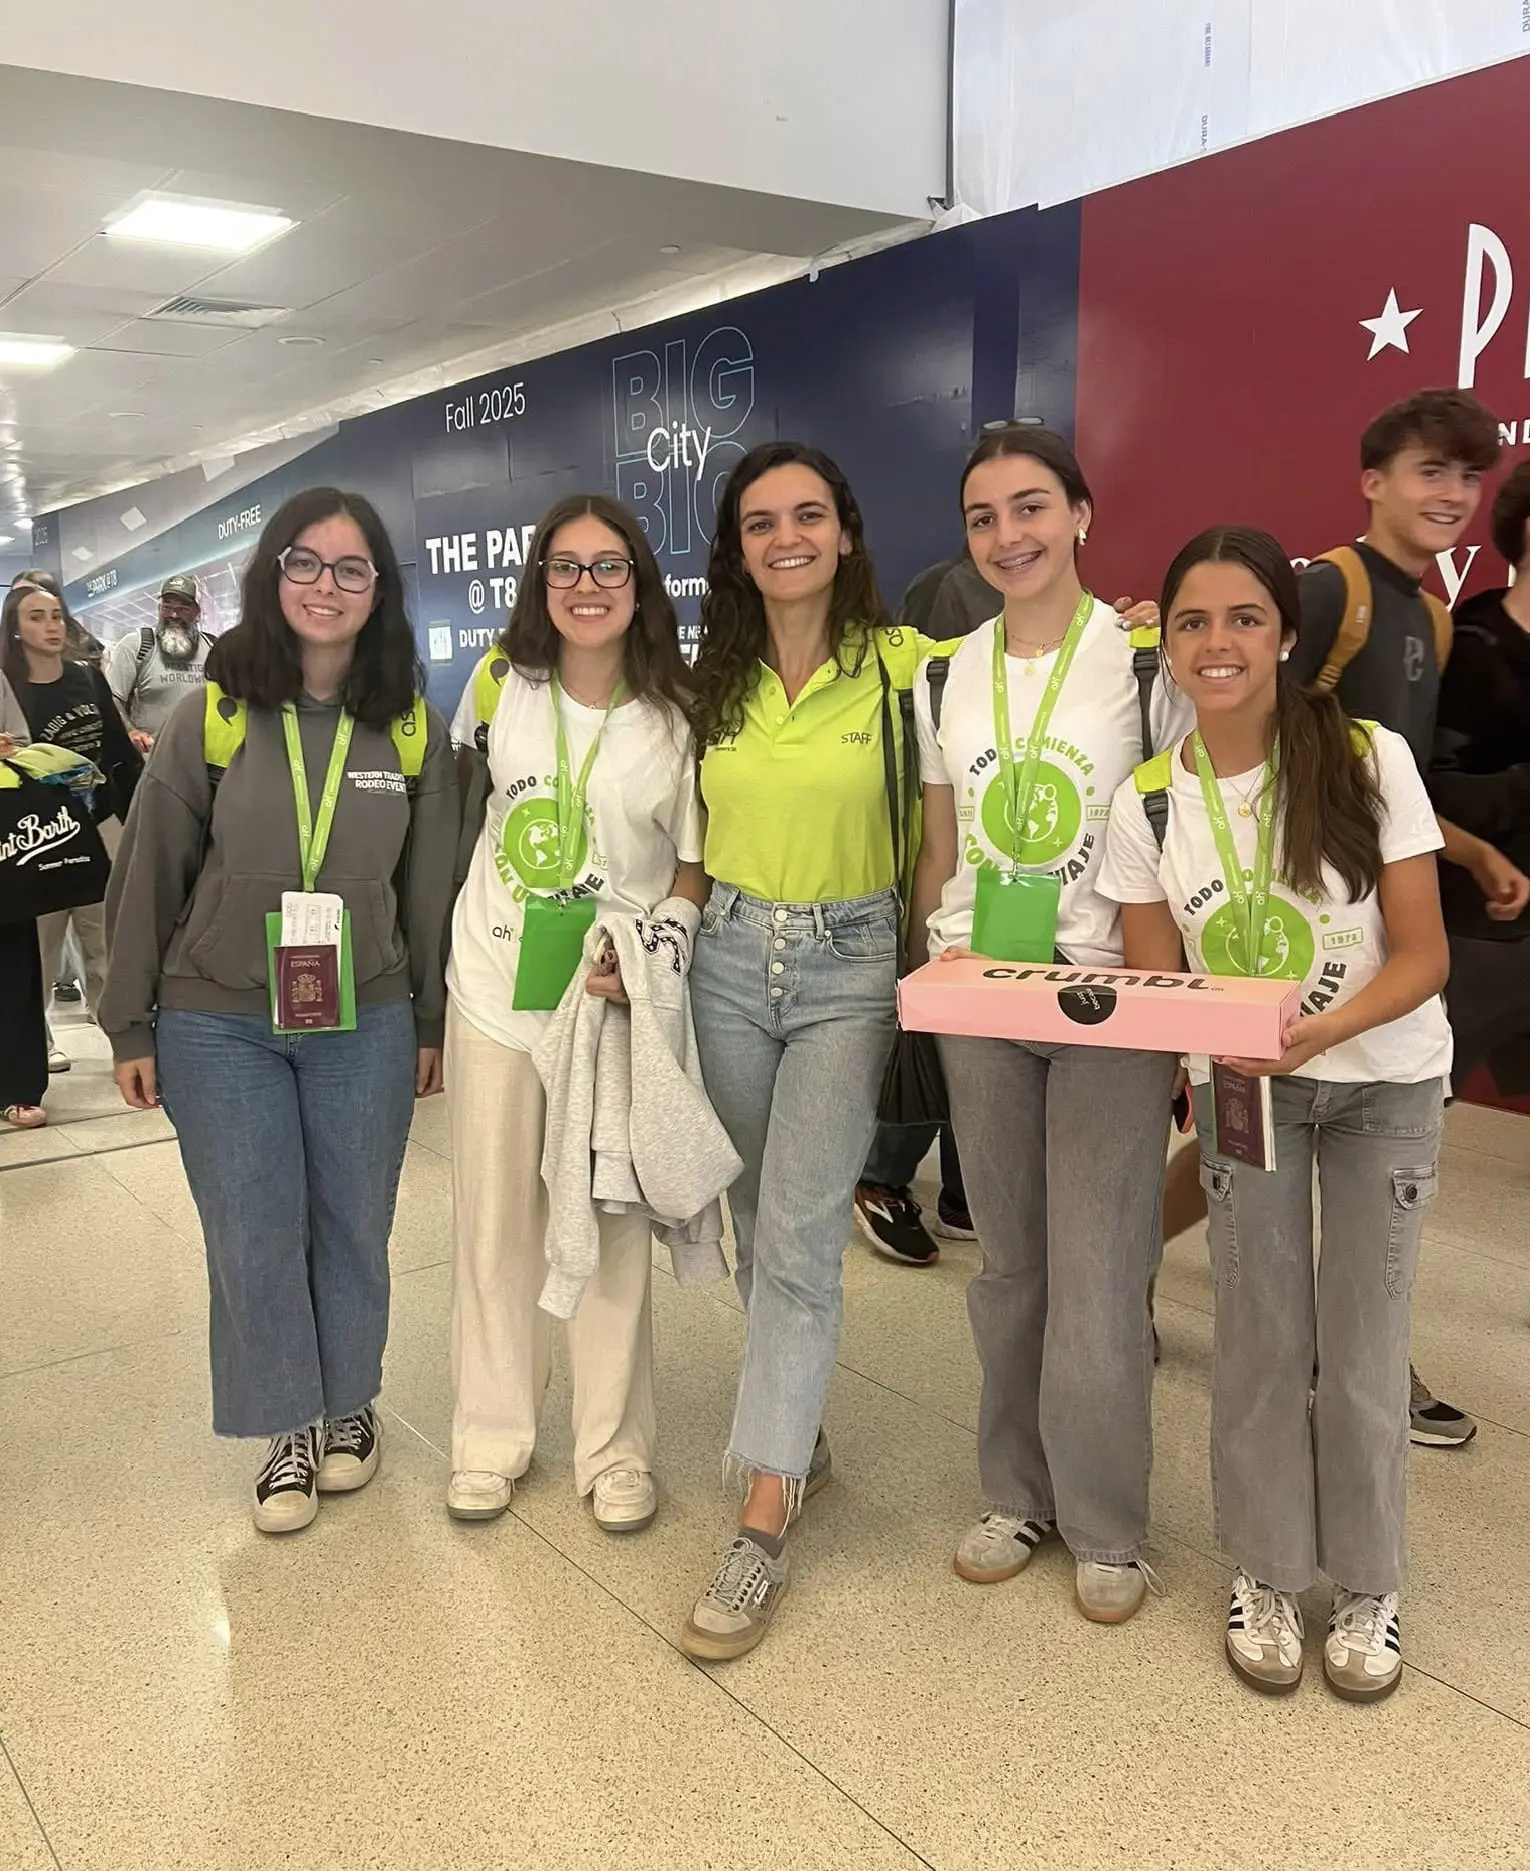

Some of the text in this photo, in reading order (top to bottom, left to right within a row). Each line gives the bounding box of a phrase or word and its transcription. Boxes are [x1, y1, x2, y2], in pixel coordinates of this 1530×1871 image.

[1458, 223, 1530, 390] P
[445, 381, 527, 433] Fall 2025
[612, 326, 755, 458] BIG
[646, 420, 712, 481] City
[218, 504, 262, 540] DUTY-FREE
[425, 524, 537, 575] THE PAR
[468, 576, 517, 615] @ T8
[840, 732, 873, 745] STAFF
[969, 736, 1096, 777] TOD CMIENZA
[355, 779, 386, 789] RODEO
[506, 775, 537, 800] TODO
[16, 805, 80, 851] Barth
[1184, 879, 1224, 916] TODO
[983, 967, 1210, 992] crumbl
